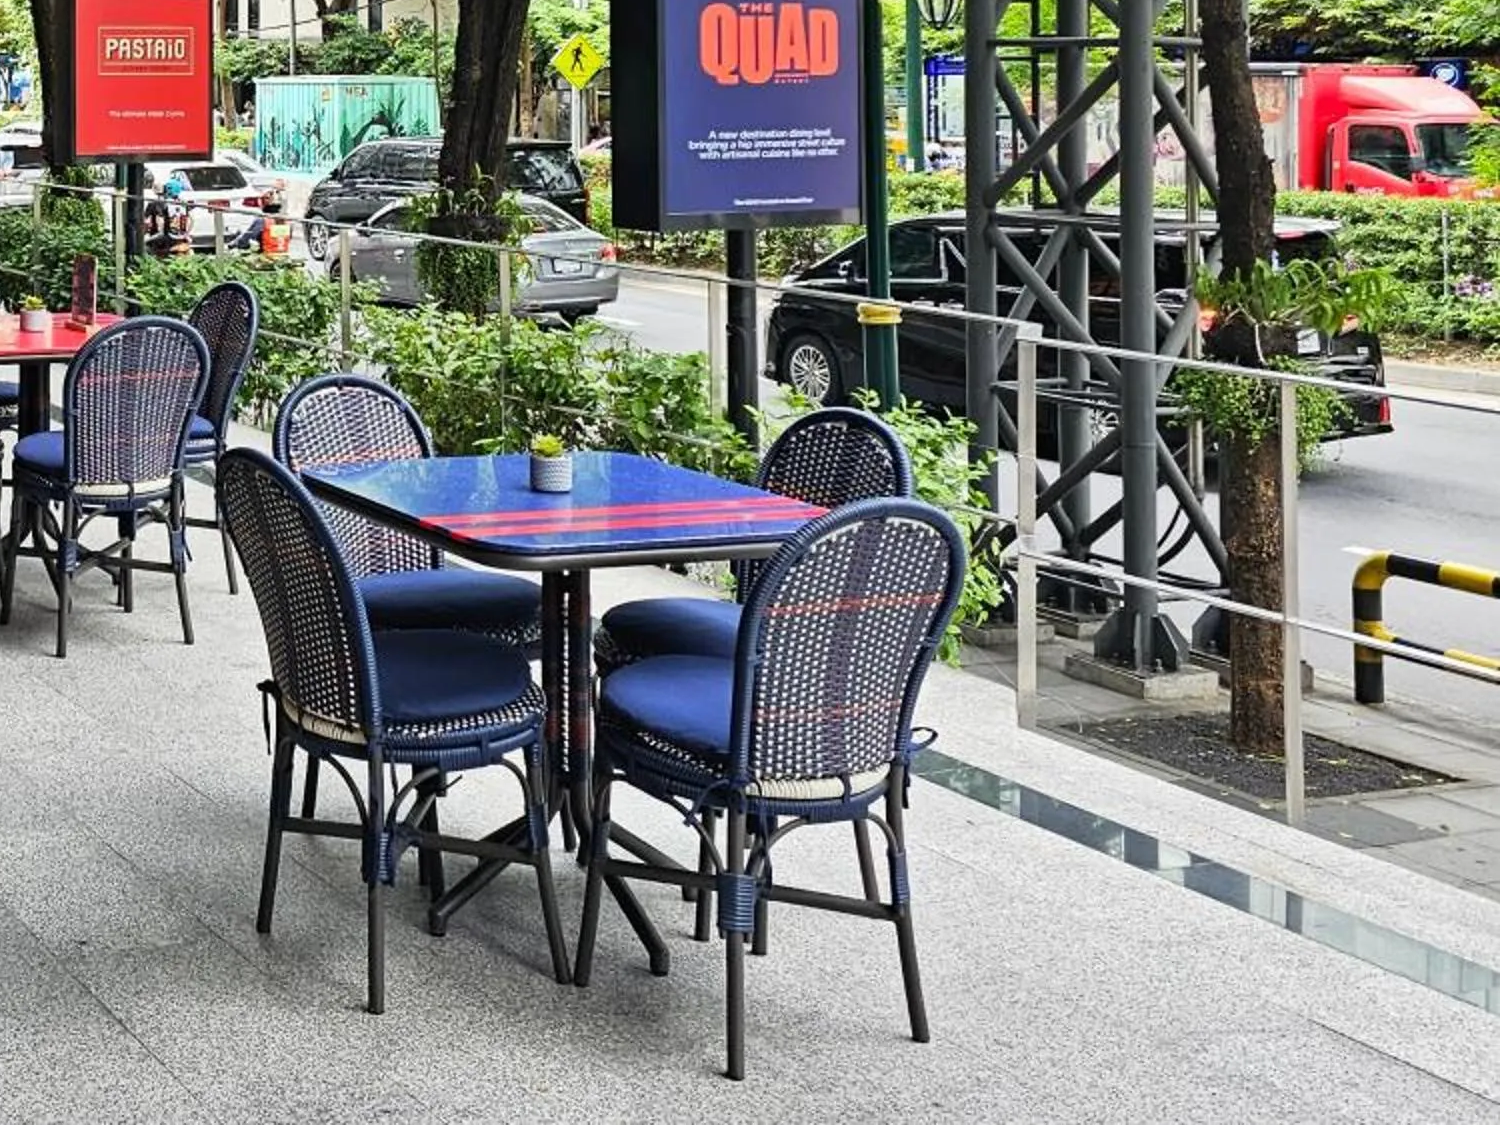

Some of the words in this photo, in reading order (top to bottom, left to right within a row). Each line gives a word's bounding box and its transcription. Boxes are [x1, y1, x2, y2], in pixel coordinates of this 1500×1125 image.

[740, 2, 774, 13] THE
[700, 2, 839, 85] QUAD
[708, 131, 717, 139] A
[699, 149, 721, 159] with
